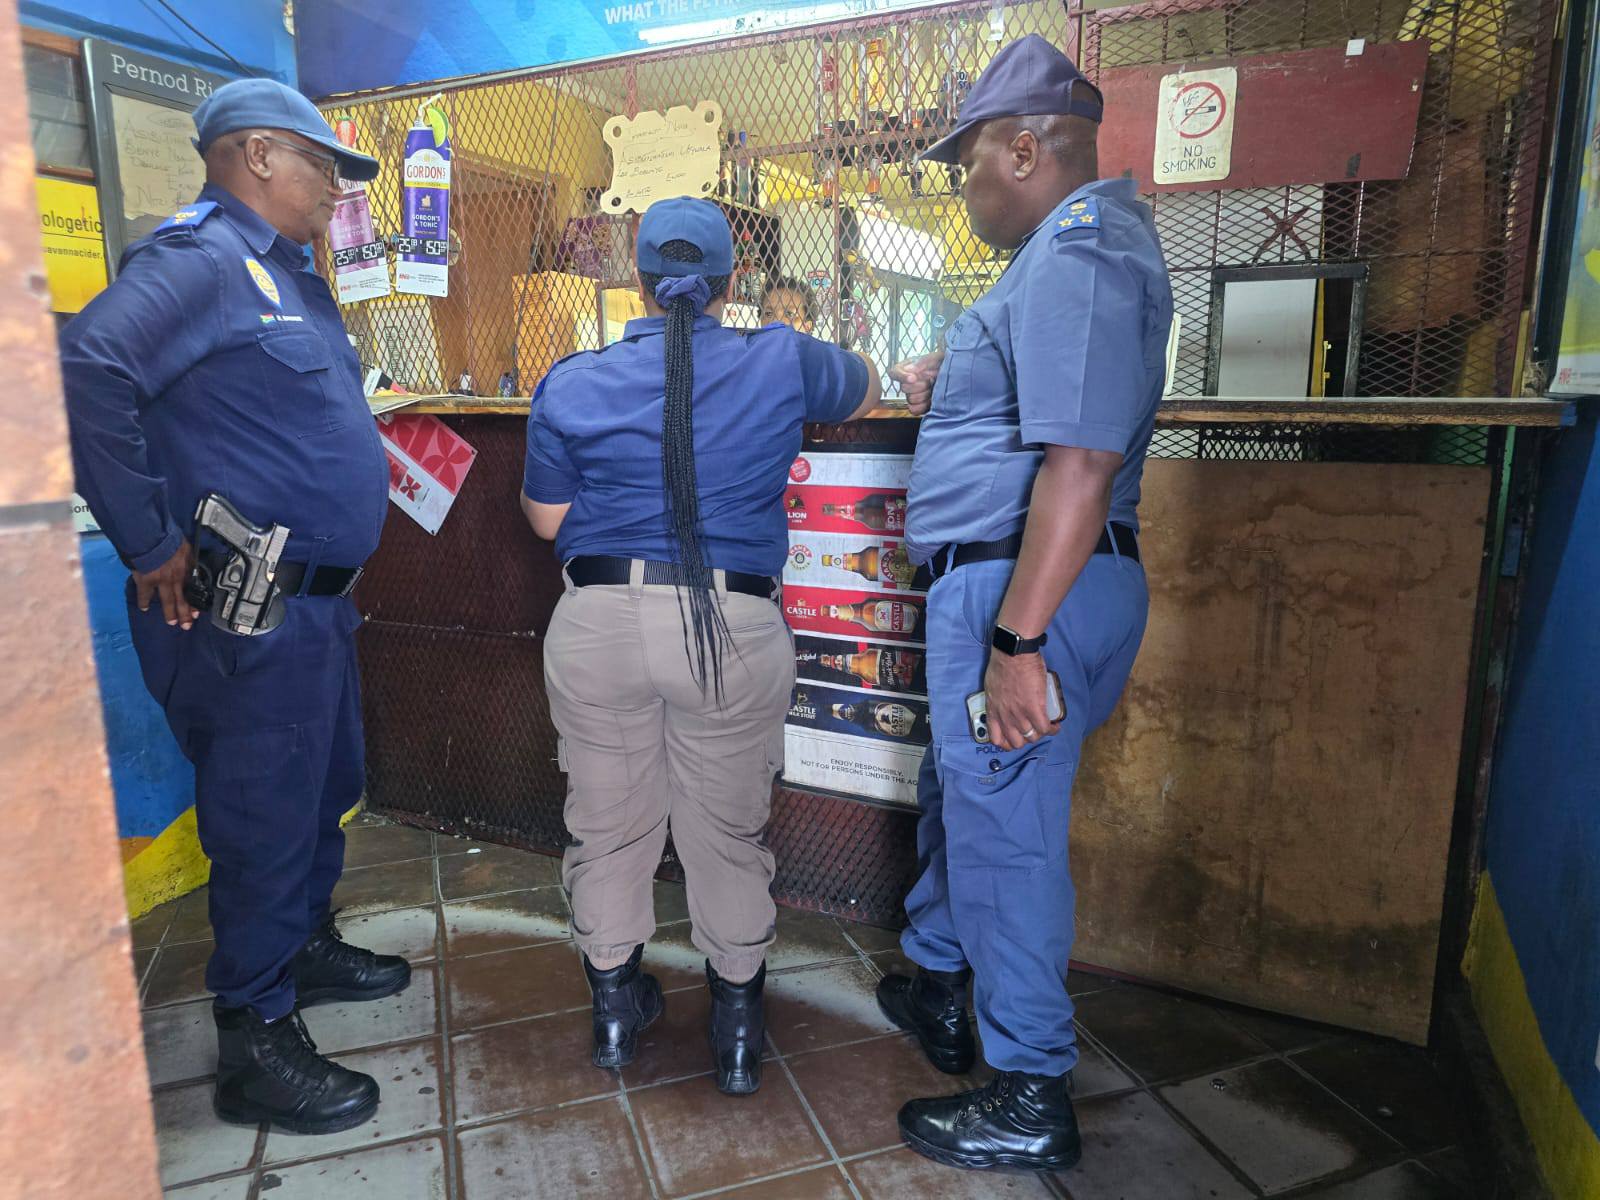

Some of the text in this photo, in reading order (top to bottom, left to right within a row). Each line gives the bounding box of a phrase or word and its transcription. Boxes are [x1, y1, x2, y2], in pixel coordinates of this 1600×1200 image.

[604, 1, 654, 24] WHAT
[657, 0, 689, 16] THE
[110, 53, 190, 93] Pernod
[1183, 144, 1203, 158] NO
[1162, 156, 1217, 174] SMOKING
[787, 511, 807, 519] LION
[786, 606, 817, 617] CASTLE
[892, 602, 901, 632] CASTLE
[891, 704, 900, 735] CASTLE
[801, 759, 815, 767] NOT
[816, 762, 830, 770] FOR
[831, 765, 864, 776] PERSONS
[865, 770, 890, 781] UNDER
[891, 776, 905, 784] THE
[830, 758, 904, 777] ENJOY RESPONSIBLY.
